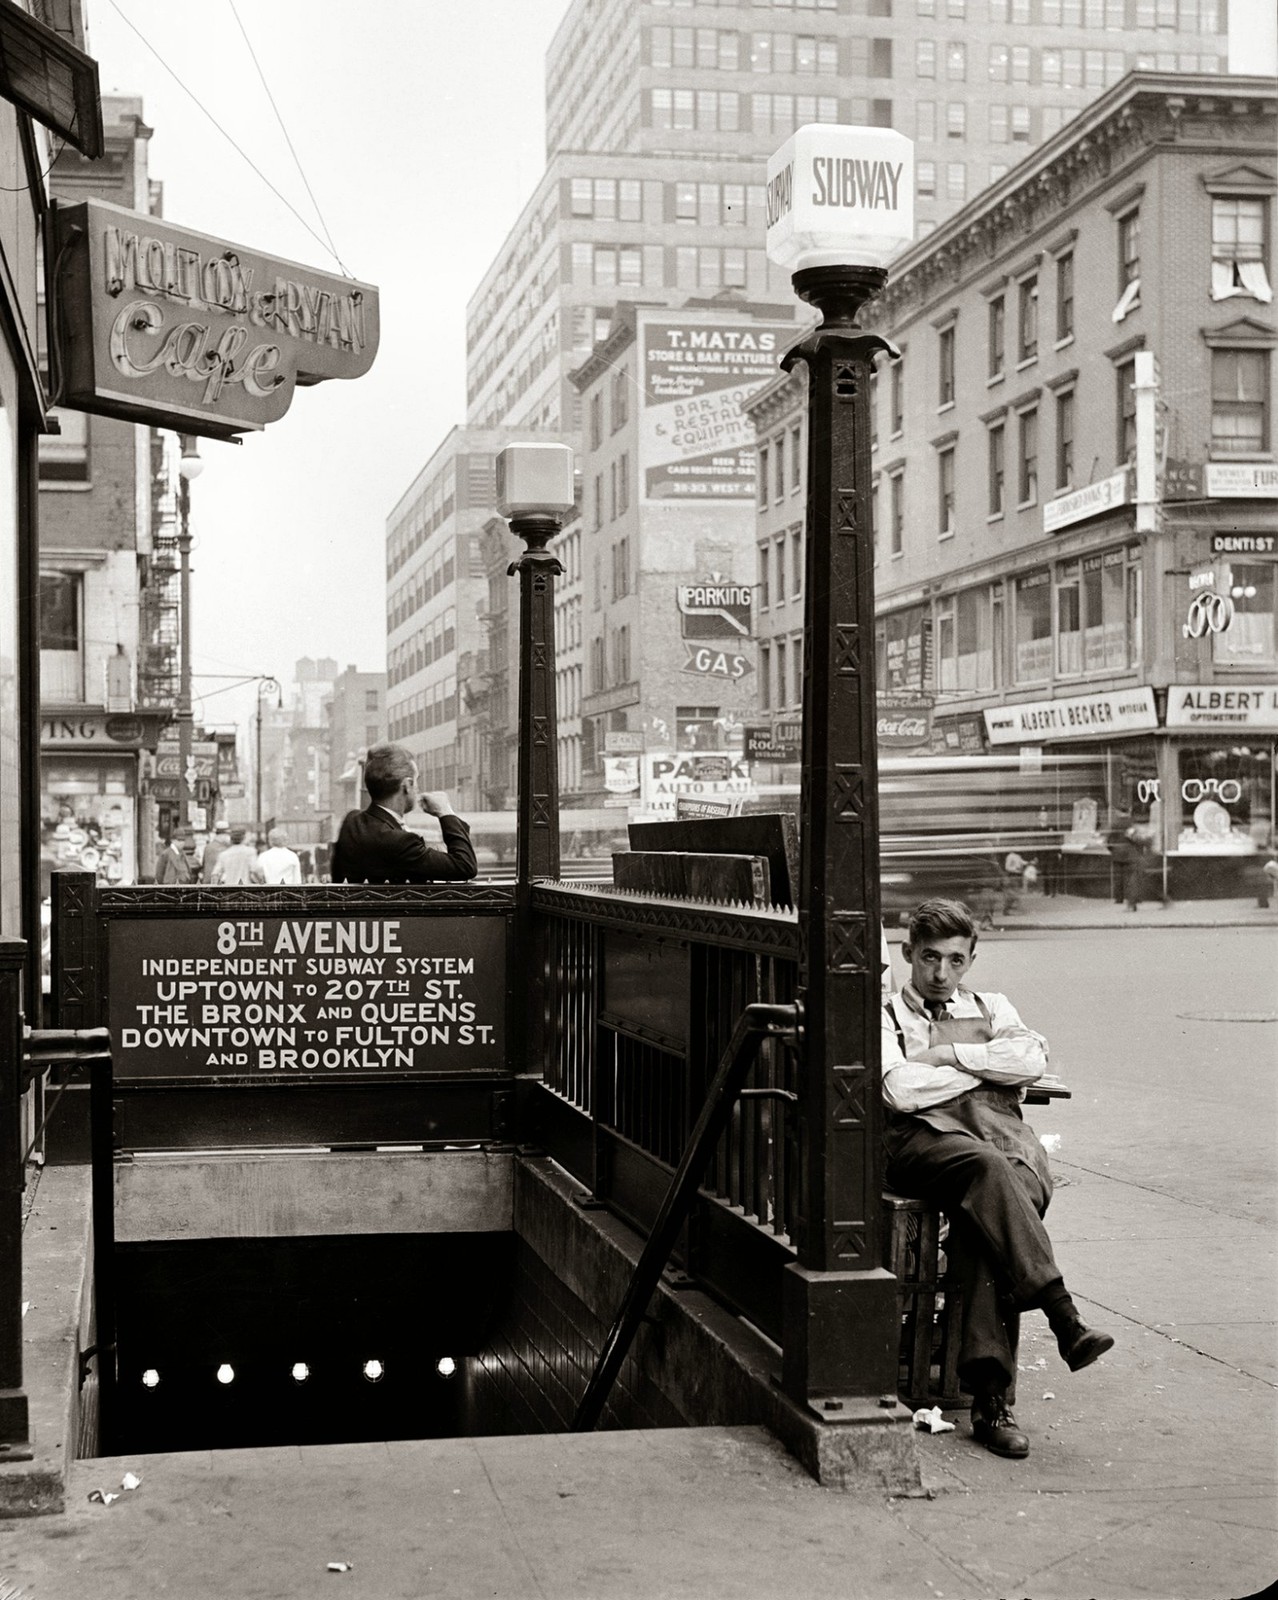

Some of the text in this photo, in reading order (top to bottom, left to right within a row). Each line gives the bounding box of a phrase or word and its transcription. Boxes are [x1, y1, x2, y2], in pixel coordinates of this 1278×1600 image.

[813, 157, 903, 210] SUBWAY
[111, 301, 285, 404] Cafe
[648, 350, 683, 361] STORE
[685, 350, 694, 362] &
[697, 352, 721, 362] BAR
[724, 352, 775, 364] FIXTURE
[674, 399, 713, 417] BAR
[711, 483, 740, 493] WEST
[1214, 537, 1275, 551] DENTIST
[685, 587, 751, 606] PARKING
[695, 649, 746, 678] GAS
[1182, 692, 1264, 709] ALBERT
[1021, 709, 1056, 731] ALBERT
[1058, 707, 1065, 727] L
[1068, 702, 1113, 726] BECKER
[656, 782, 704, 794] AUTO
[217, 921, 402, 955] 8TH AVENUE
[143, 957, 474, 976] INDEPENDENT SUBWAY SYSTEM
[156, 979, 463, 1000] UPTOWN TO 207TH ST.
[136, 1002, 476, 1025] THE BRONX AND QUEENS
[121, 1025, 496, 1048] DOWNTOWN TO FULTON ST.
[205, 1048, 414, 1069] AND BROOKLYN
